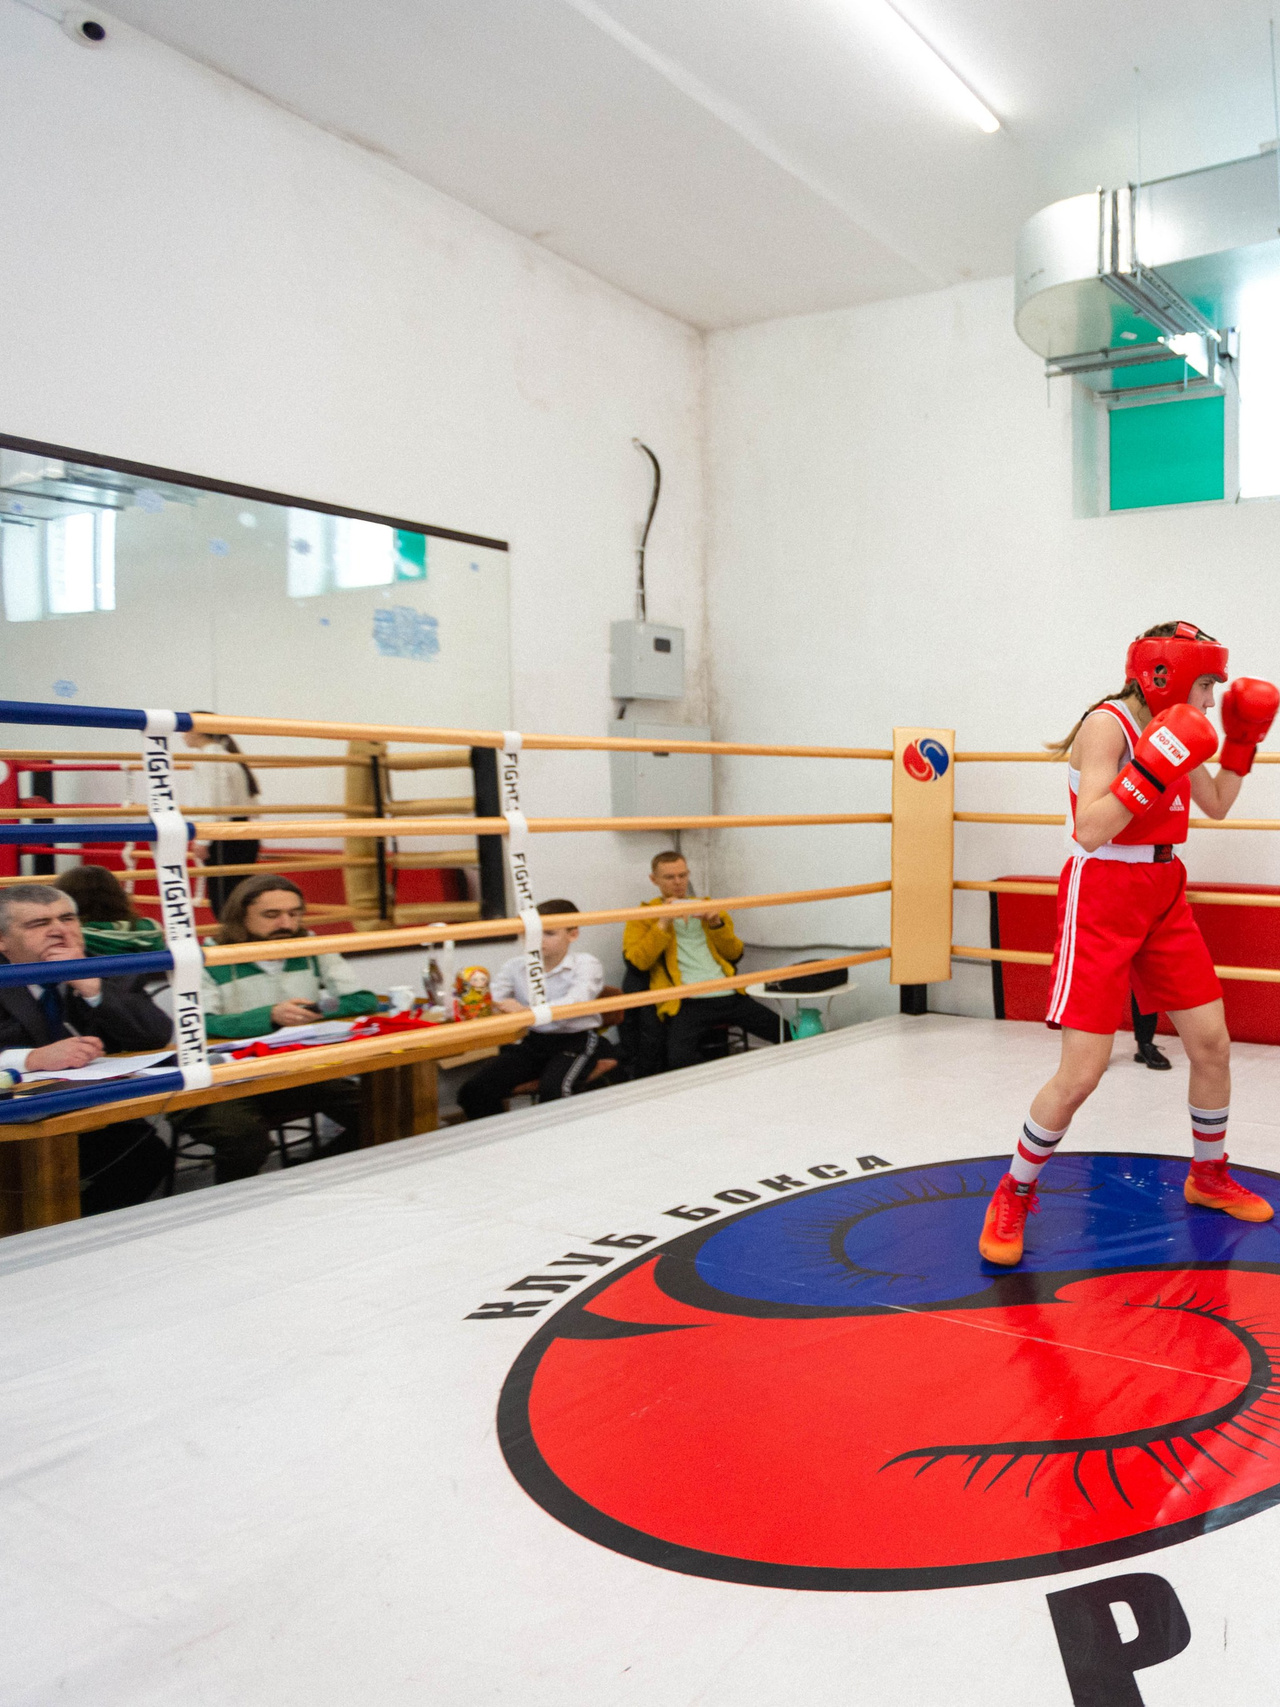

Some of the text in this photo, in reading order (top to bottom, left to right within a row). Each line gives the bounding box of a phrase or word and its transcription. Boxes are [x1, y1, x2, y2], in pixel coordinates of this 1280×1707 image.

[146, 736, 173, 800] FIGHT
[1156, 733, 1169, 746] TOP
[1168, 745, 1184, 760] TEN
[504, 753, 519, 801] FIGHT
[1121, 777, 1149, 805] TOP TEN
[161, 865, 190, 928] FIGHT
[513, 853, 533, 900] FIGHT
[528, 950, 545, 995] FIGHT
[178, 991, 202, 1053] FIGHT
[462, 1154, 894, 1321] КЛУБ БОКСА
